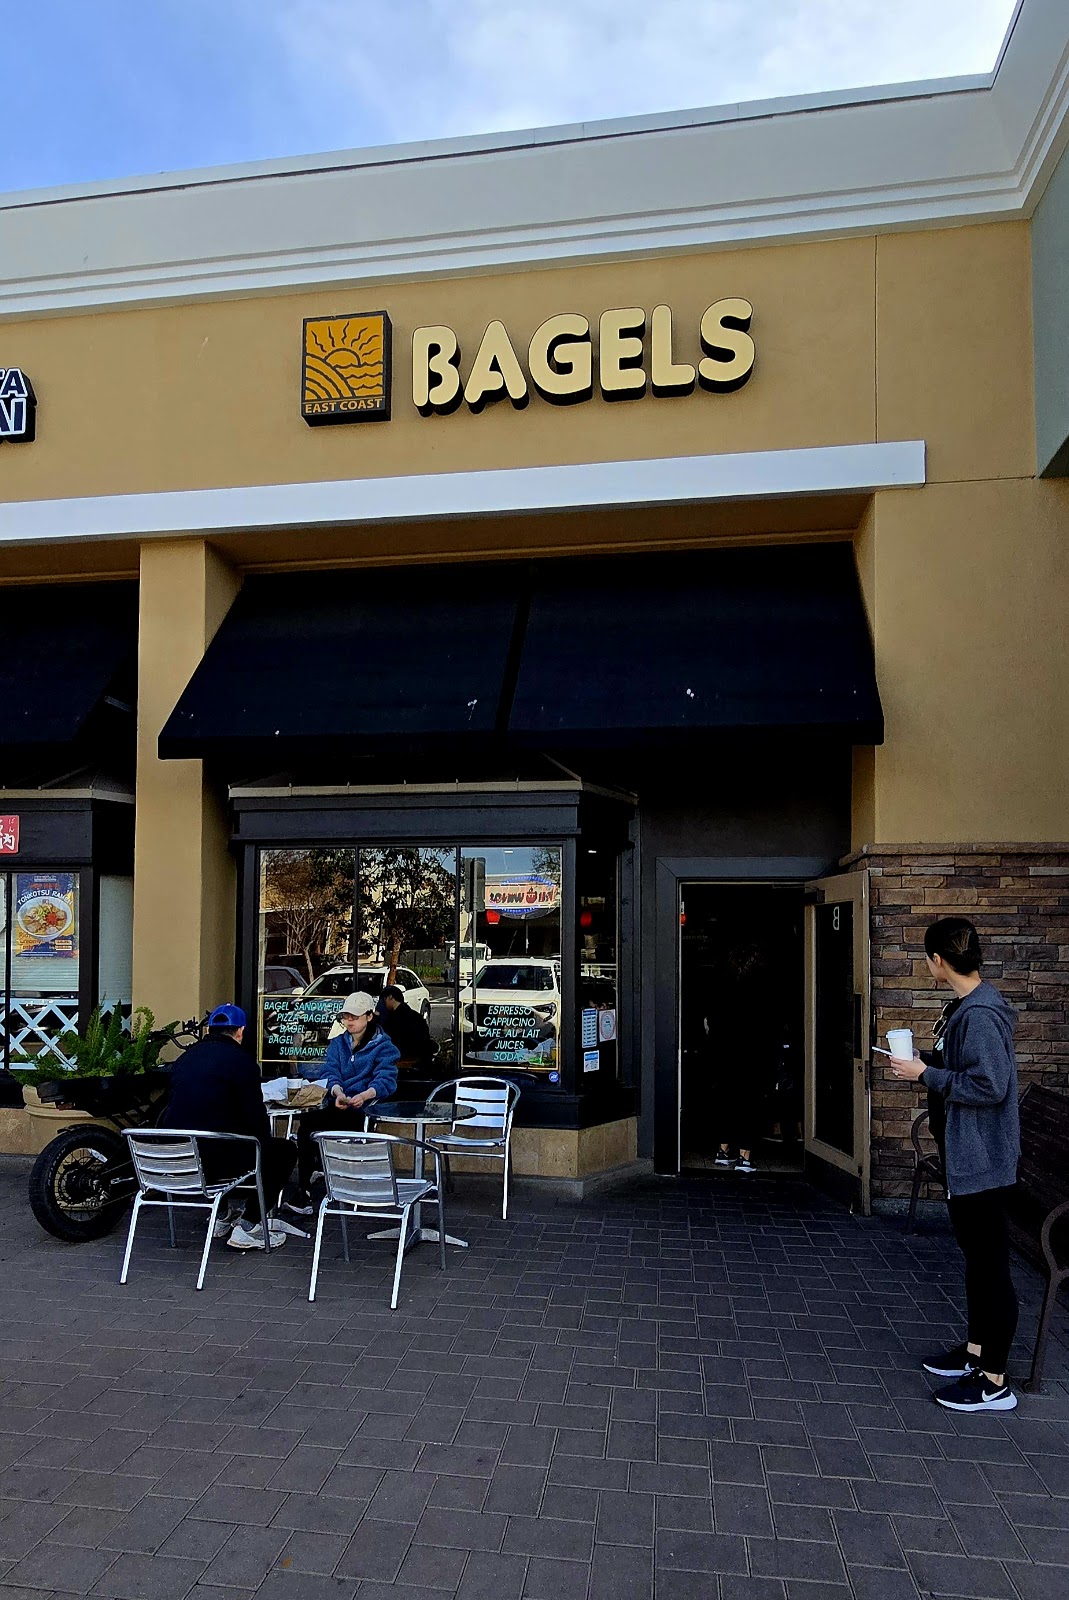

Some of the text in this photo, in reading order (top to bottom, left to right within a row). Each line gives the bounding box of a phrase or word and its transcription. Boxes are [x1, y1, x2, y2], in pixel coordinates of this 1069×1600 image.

[412, 297, 756, 408] BAGELS
[0, 368, 28, 398] A
[305, 398, 383, 414] EAST COAST
[17, 889, 50, 905] TONKOTSU
[263, 1001, 344, 1013] BAGEL SANDWICHE
[488, 1005, 533, 1016] ESPRESSO
[276, 1012, 336, 1023] PIZZA BAGELS
[483, 1016, 537, 1027] CAPPUCINO
[280, 1024, 305, 1034] BAGEL
[478, 1028, 541, 1039] CAFE AU LAIT
[268, 1035, 294, 1045] BAGEL
[494, 1040, 525, 1050] JUICES
[493, 1051, 525, 1061] SODAS
